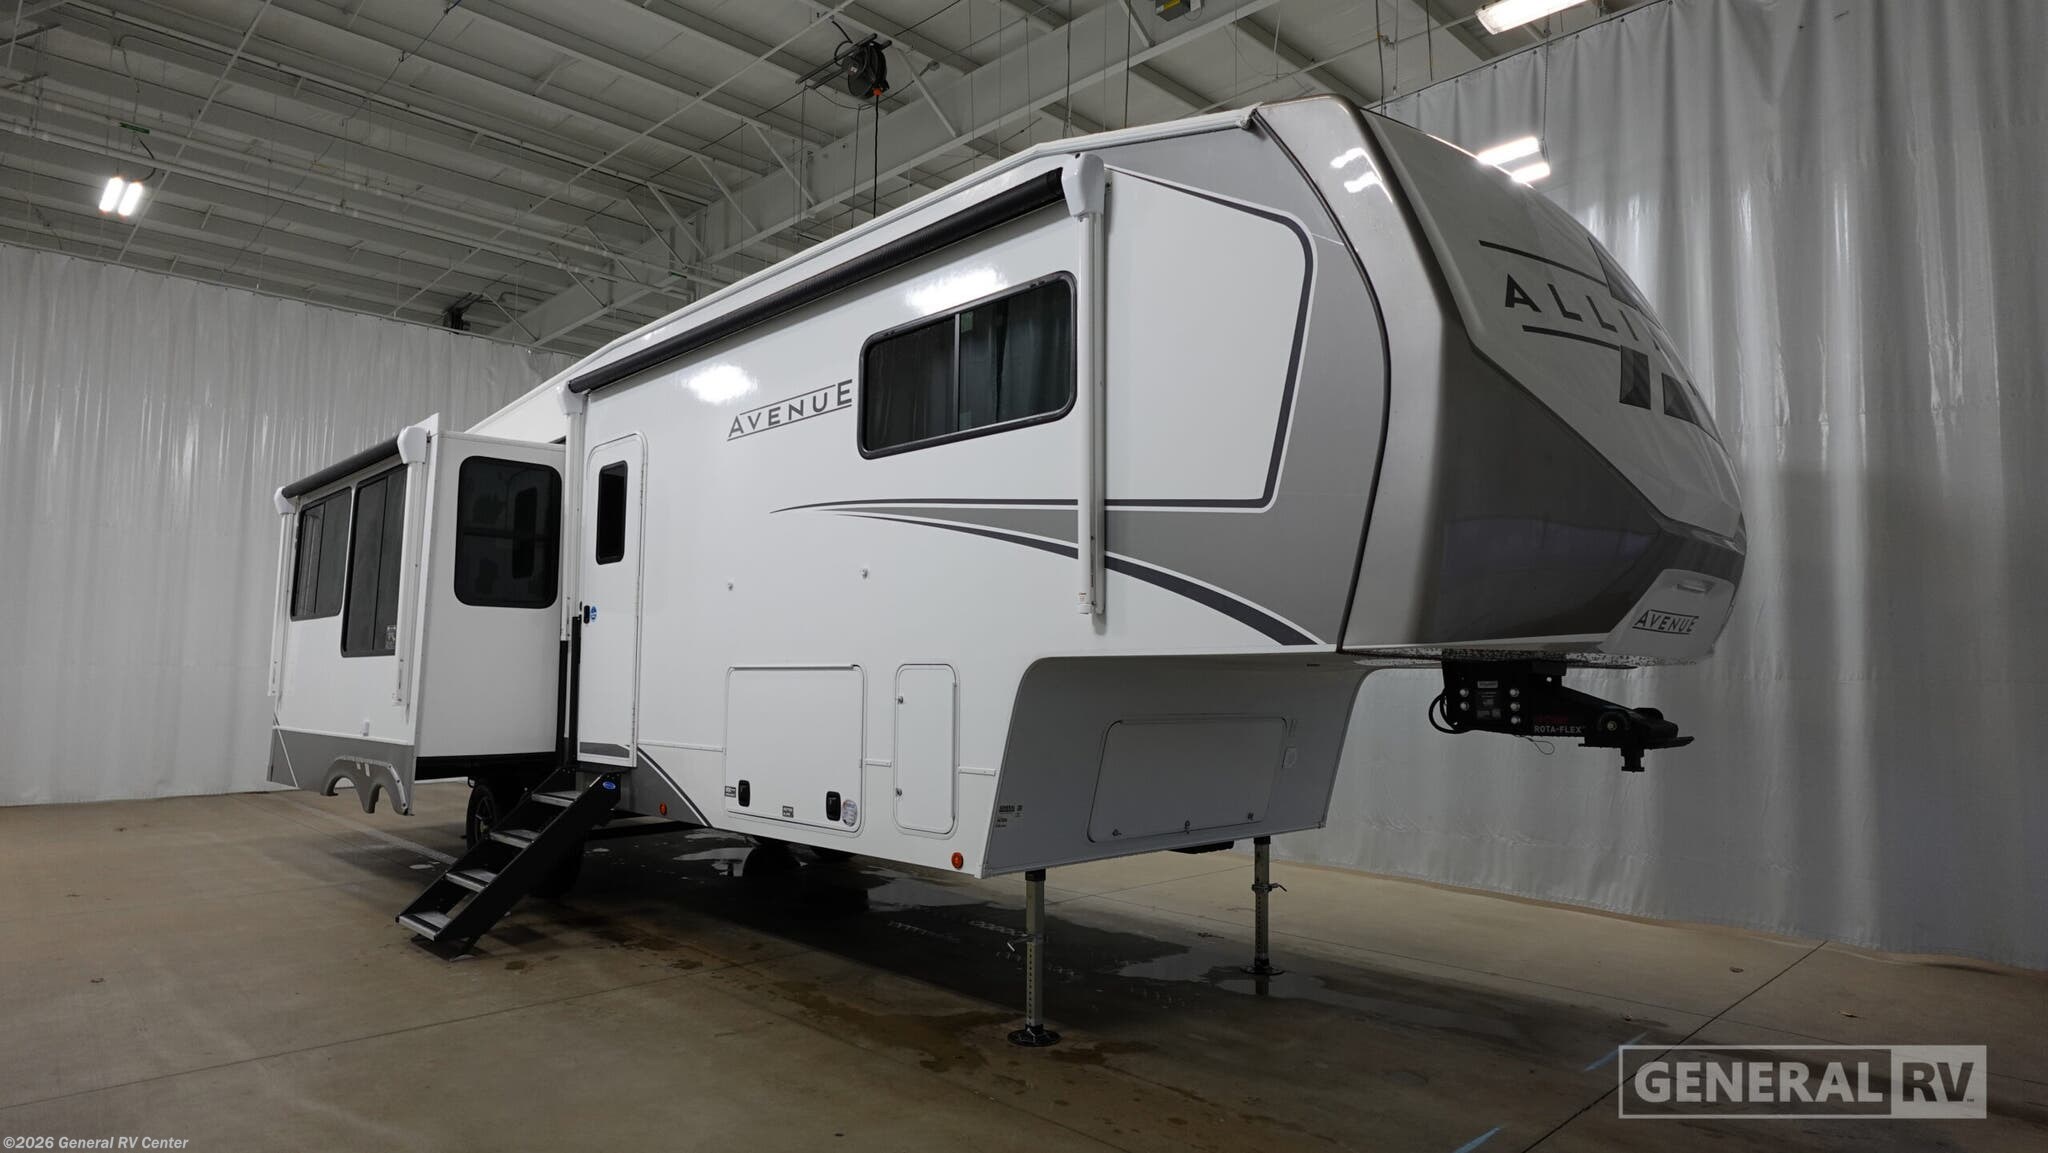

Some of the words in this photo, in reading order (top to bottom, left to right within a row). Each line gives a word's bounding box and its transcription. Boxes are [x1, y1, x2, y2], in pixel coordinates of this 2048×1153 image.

[1504, 273, 1640, 341] ALLI
[727, 379, 853, 438] AVENUE
[1634, 609, 1699, 634] AVENUE
[1533, 725, 1583, 734] ROTA-FLEX
